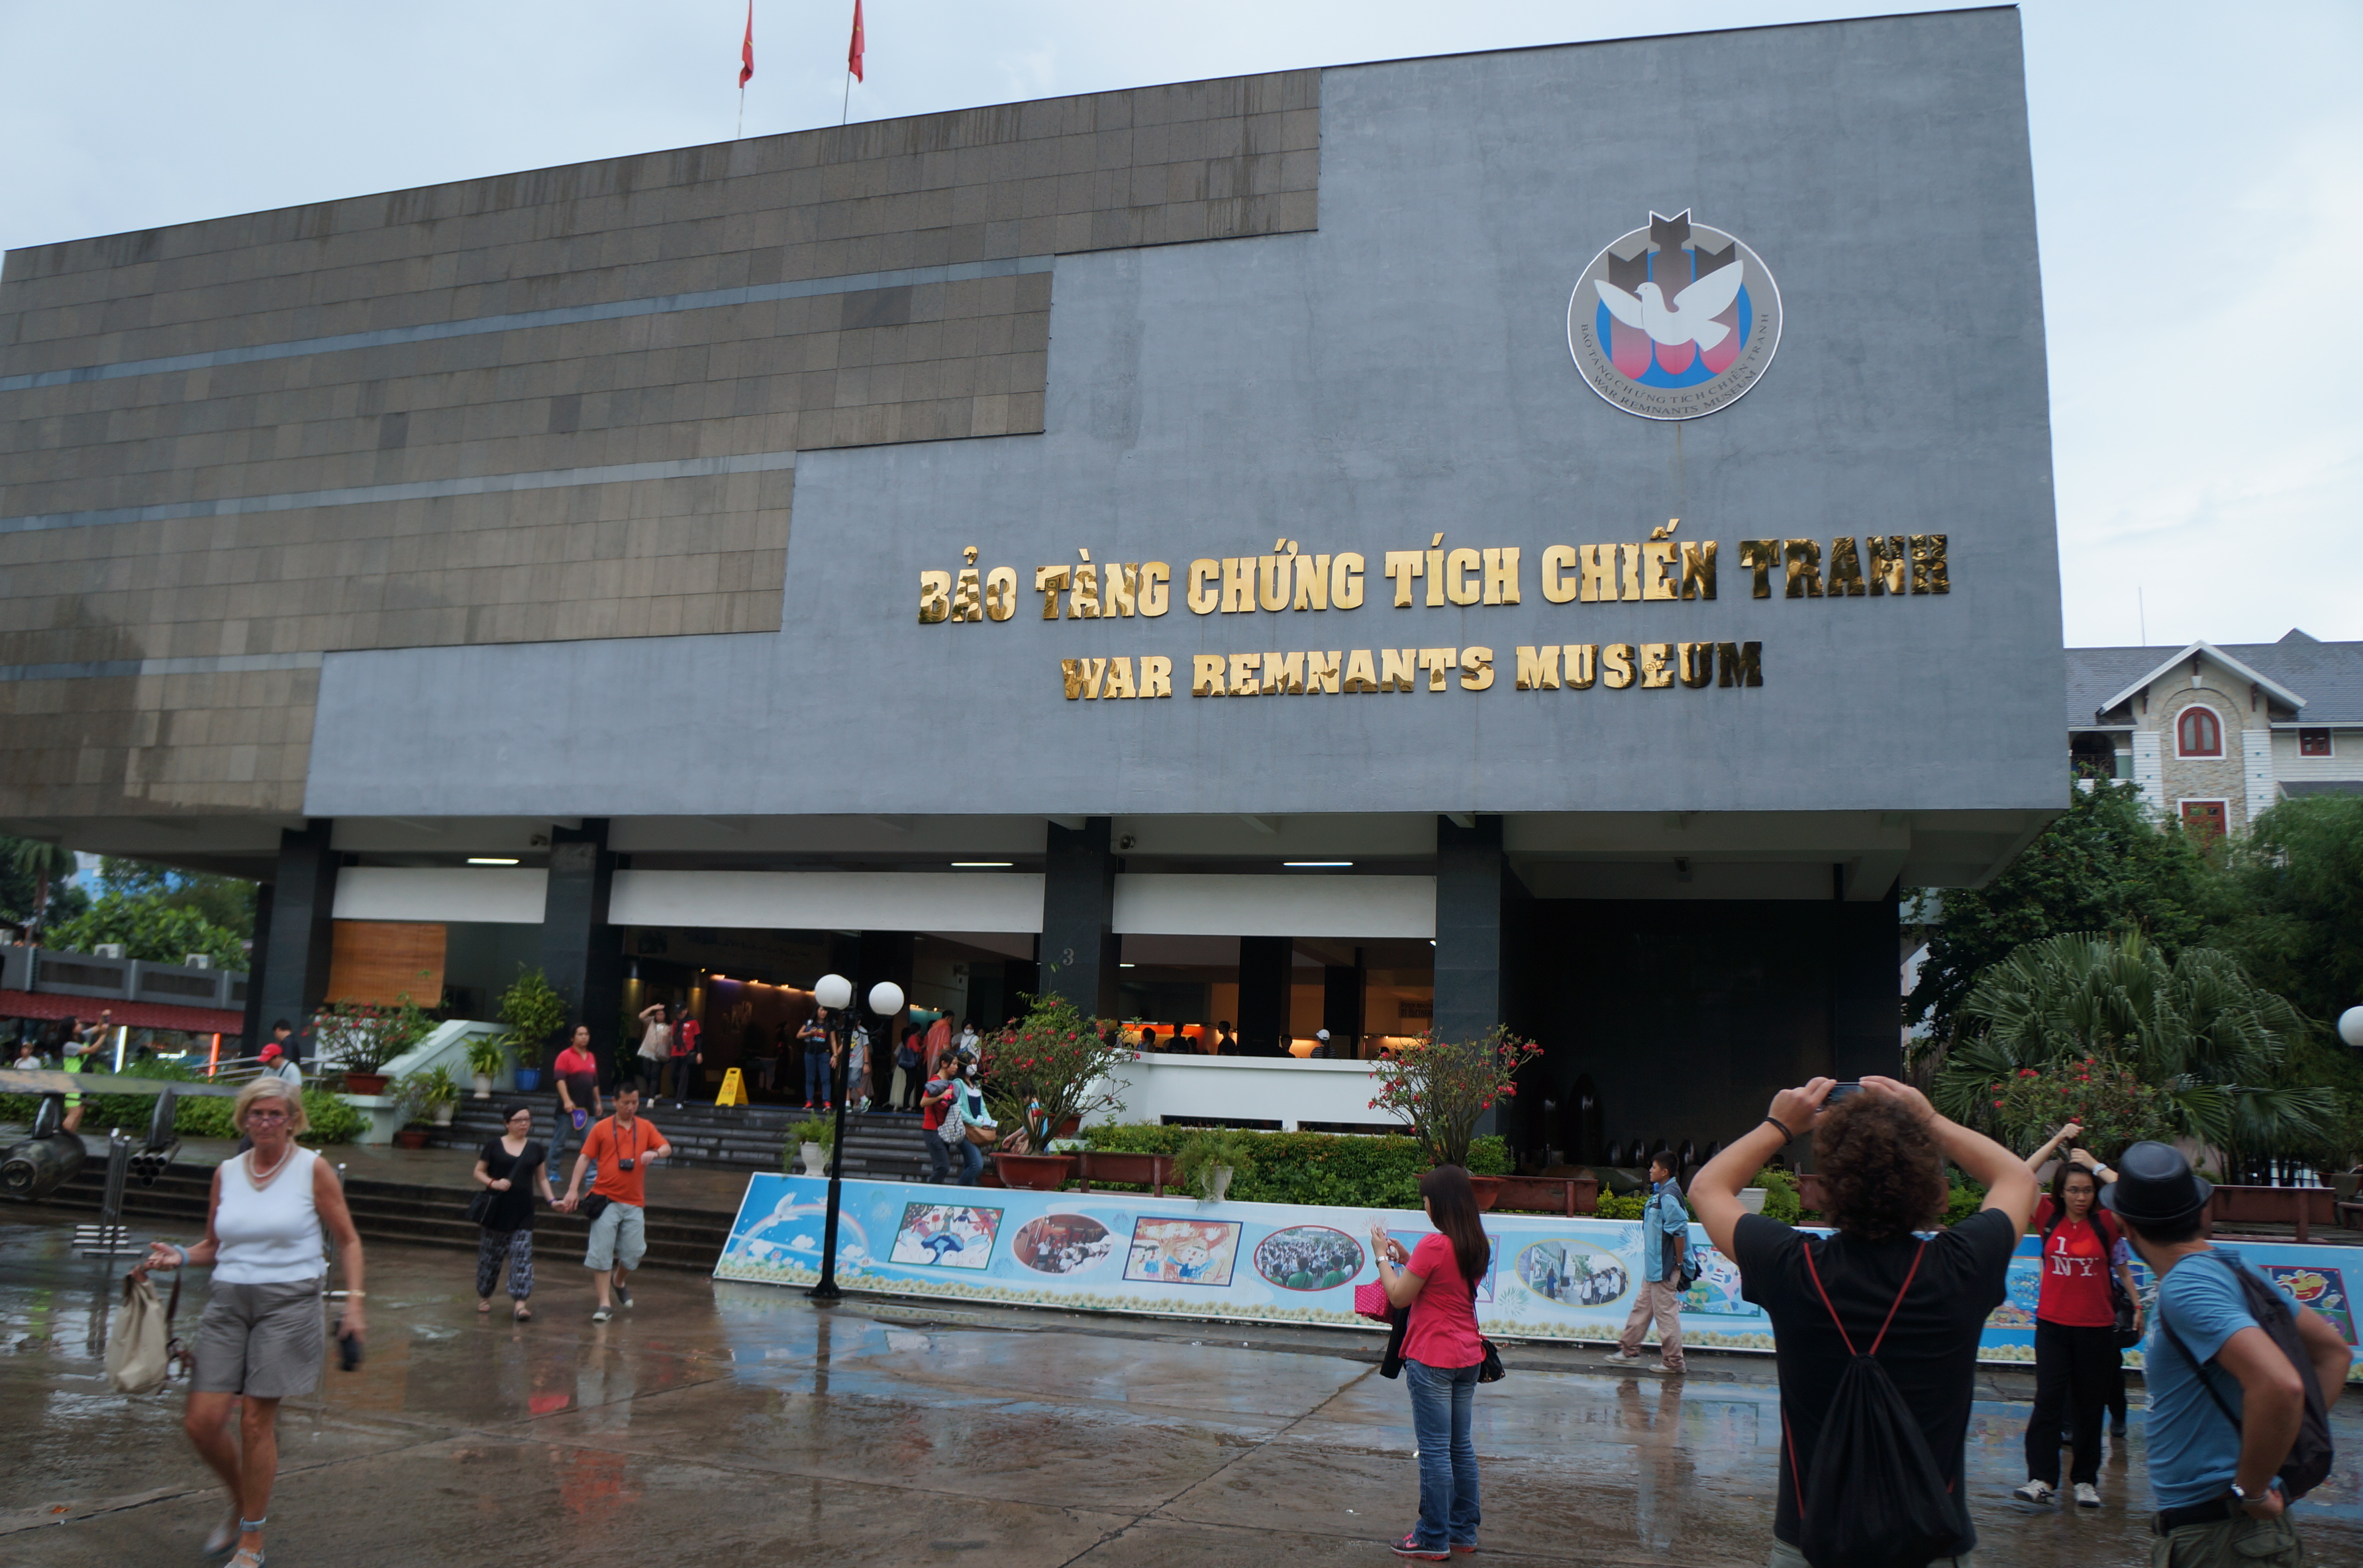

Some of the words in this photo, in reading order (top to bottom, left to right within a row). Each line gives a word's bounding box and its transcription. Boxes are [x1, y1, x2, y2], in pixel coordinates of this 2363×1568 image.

[1746, 314, 1769, 362] TRANH
[1594, 375, 1617, 399] WAR
[1620, 397, 1698, 415] REMNANTS
[1703, 370, 1757, 409] MUSEUM
[918, 546, 1018, 624] BẢO
[1035, 548, 1171, 620] TÀNG
[1187, 538, 1366, 615] CHỨNG
[1385, 532, 1521, 608] TÍCH
[1542, 518, 1719, 603] CHIẾN
[1739, 534, 1951, 599] TRANH
[1062, 656, 1172, 699] WAR
[1192, 646, 1495, 697] REMNANTS
[1515, 641, 1764, 691] MUSEUM
[1062, 948, 1074, 965] 3
[2050, 1255, 2099, 1277] NY
[2054, 1236, 2068, 1255] I
